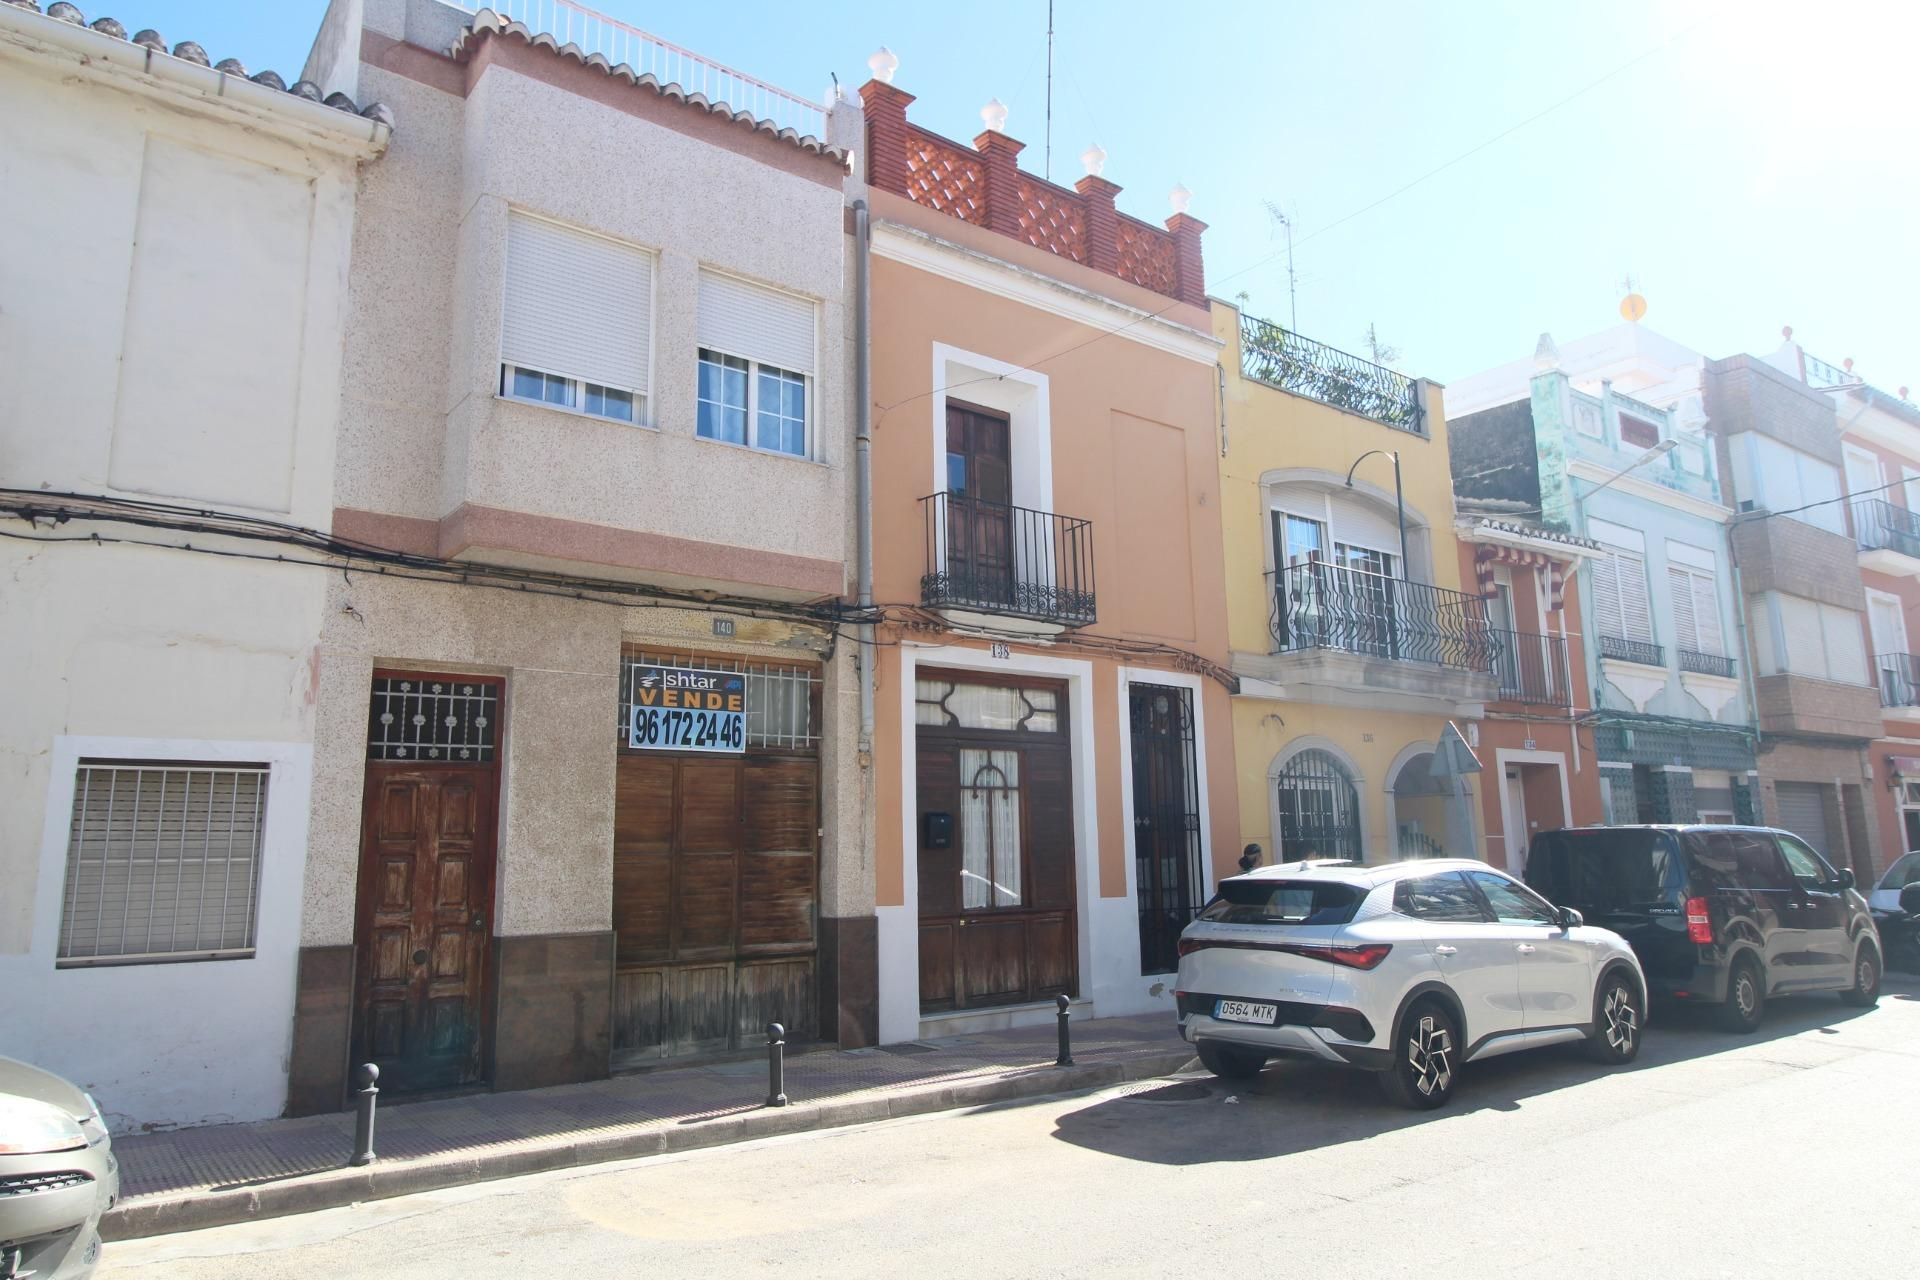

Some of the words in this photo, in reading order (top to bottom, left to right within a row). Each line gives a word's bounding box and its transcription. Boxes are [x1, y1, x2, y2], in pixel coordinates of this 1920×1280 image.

[716, 621, 732, 634] 140
[991, 642, 1010, 659] 138
[663, 670, 717, 690] Ishtar
[638, 687, 742, 711] VENDE
[635, 708, 659, 745] 96
[662, 710, 693, 746] 172
[695, 711, 718, 747] 24
[720, 713, 742, 748] 46
[1222, 1002, 1249, 1017] 0564
[1252, 1004, 1273, 1020] MTK
